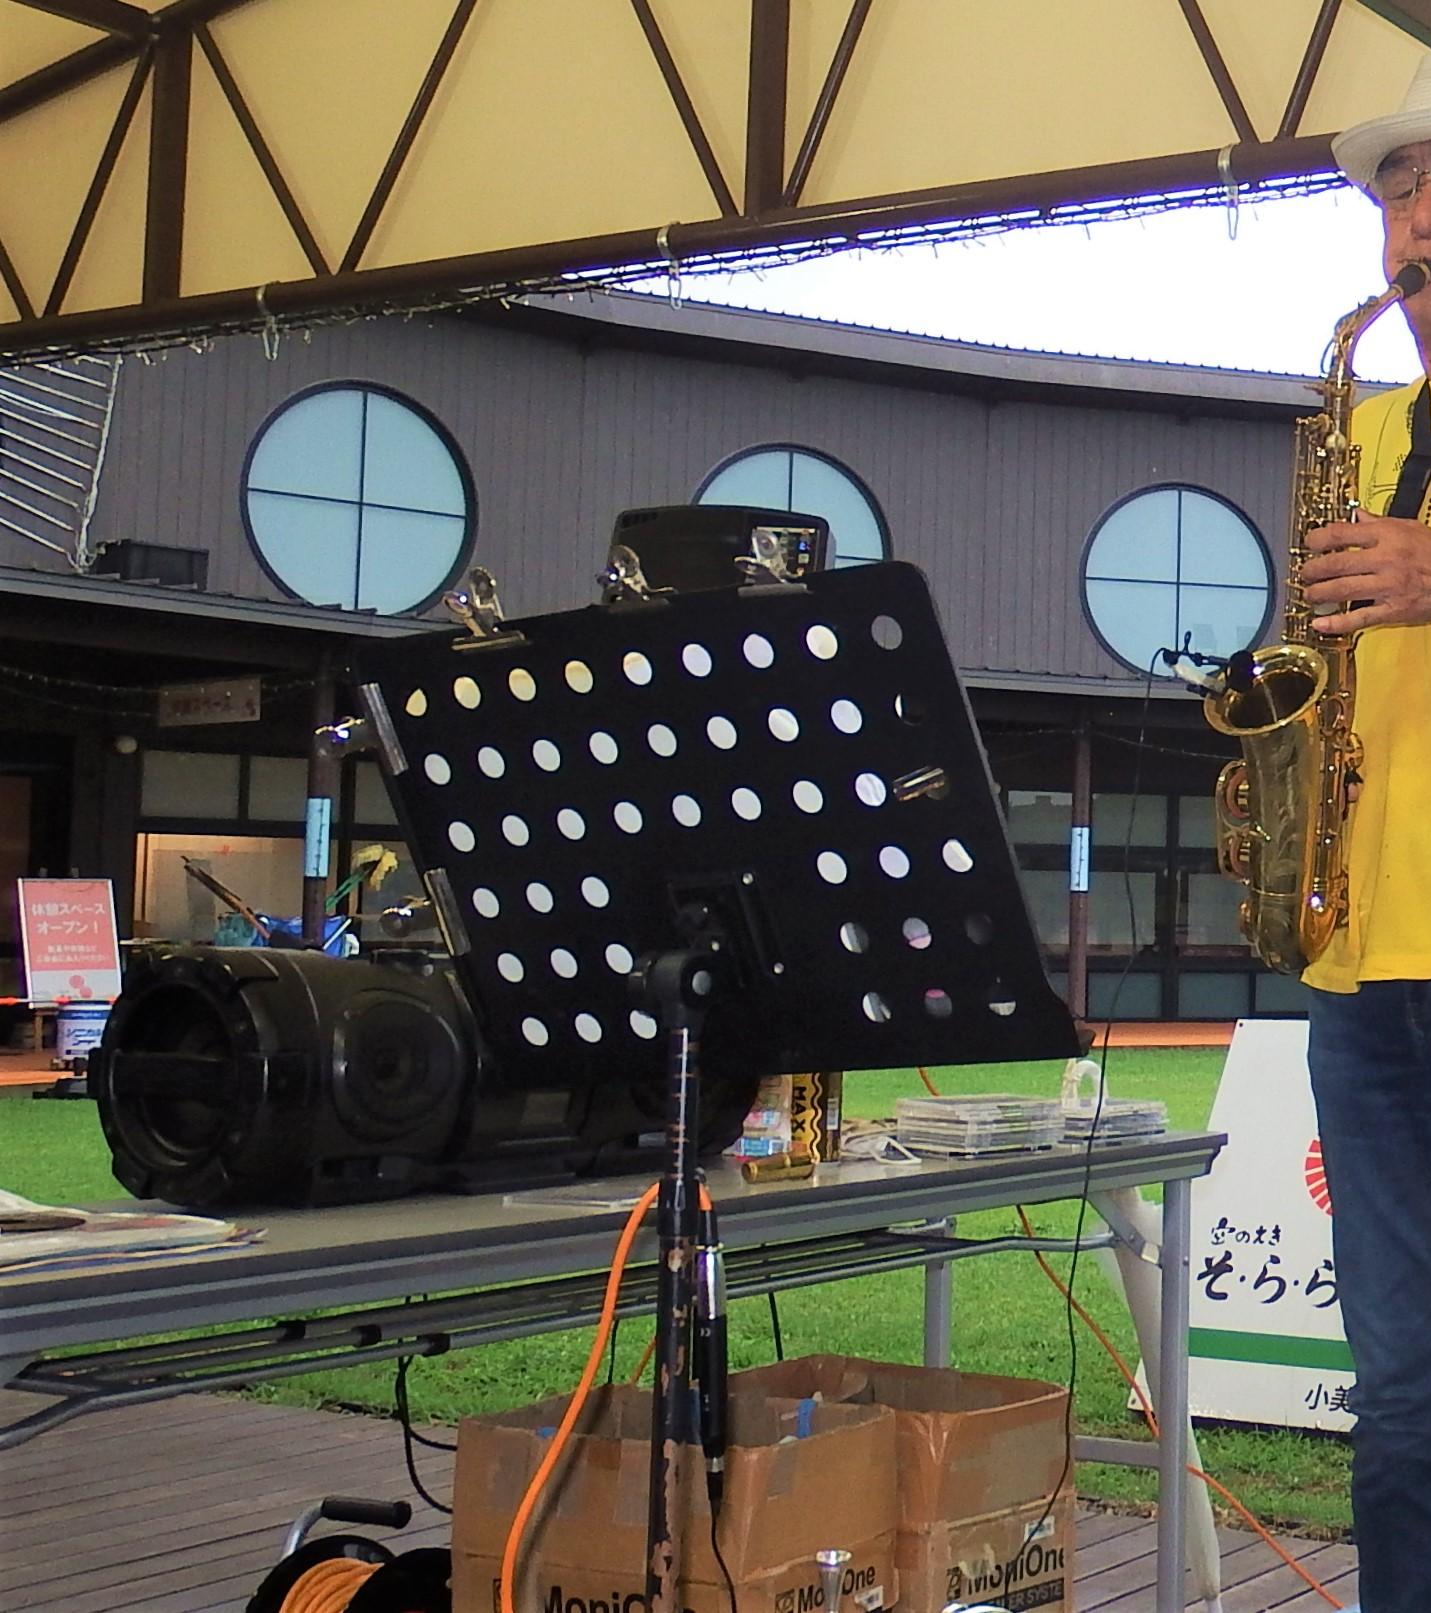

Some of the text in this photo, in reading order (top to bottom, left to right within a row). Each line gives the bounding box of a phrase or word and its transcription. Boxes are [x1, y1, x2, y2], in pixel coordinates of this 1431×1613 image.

[1211, 1217, 1282, 1246] 空のえき
[798, 1566, 876, 1612] MoOne
